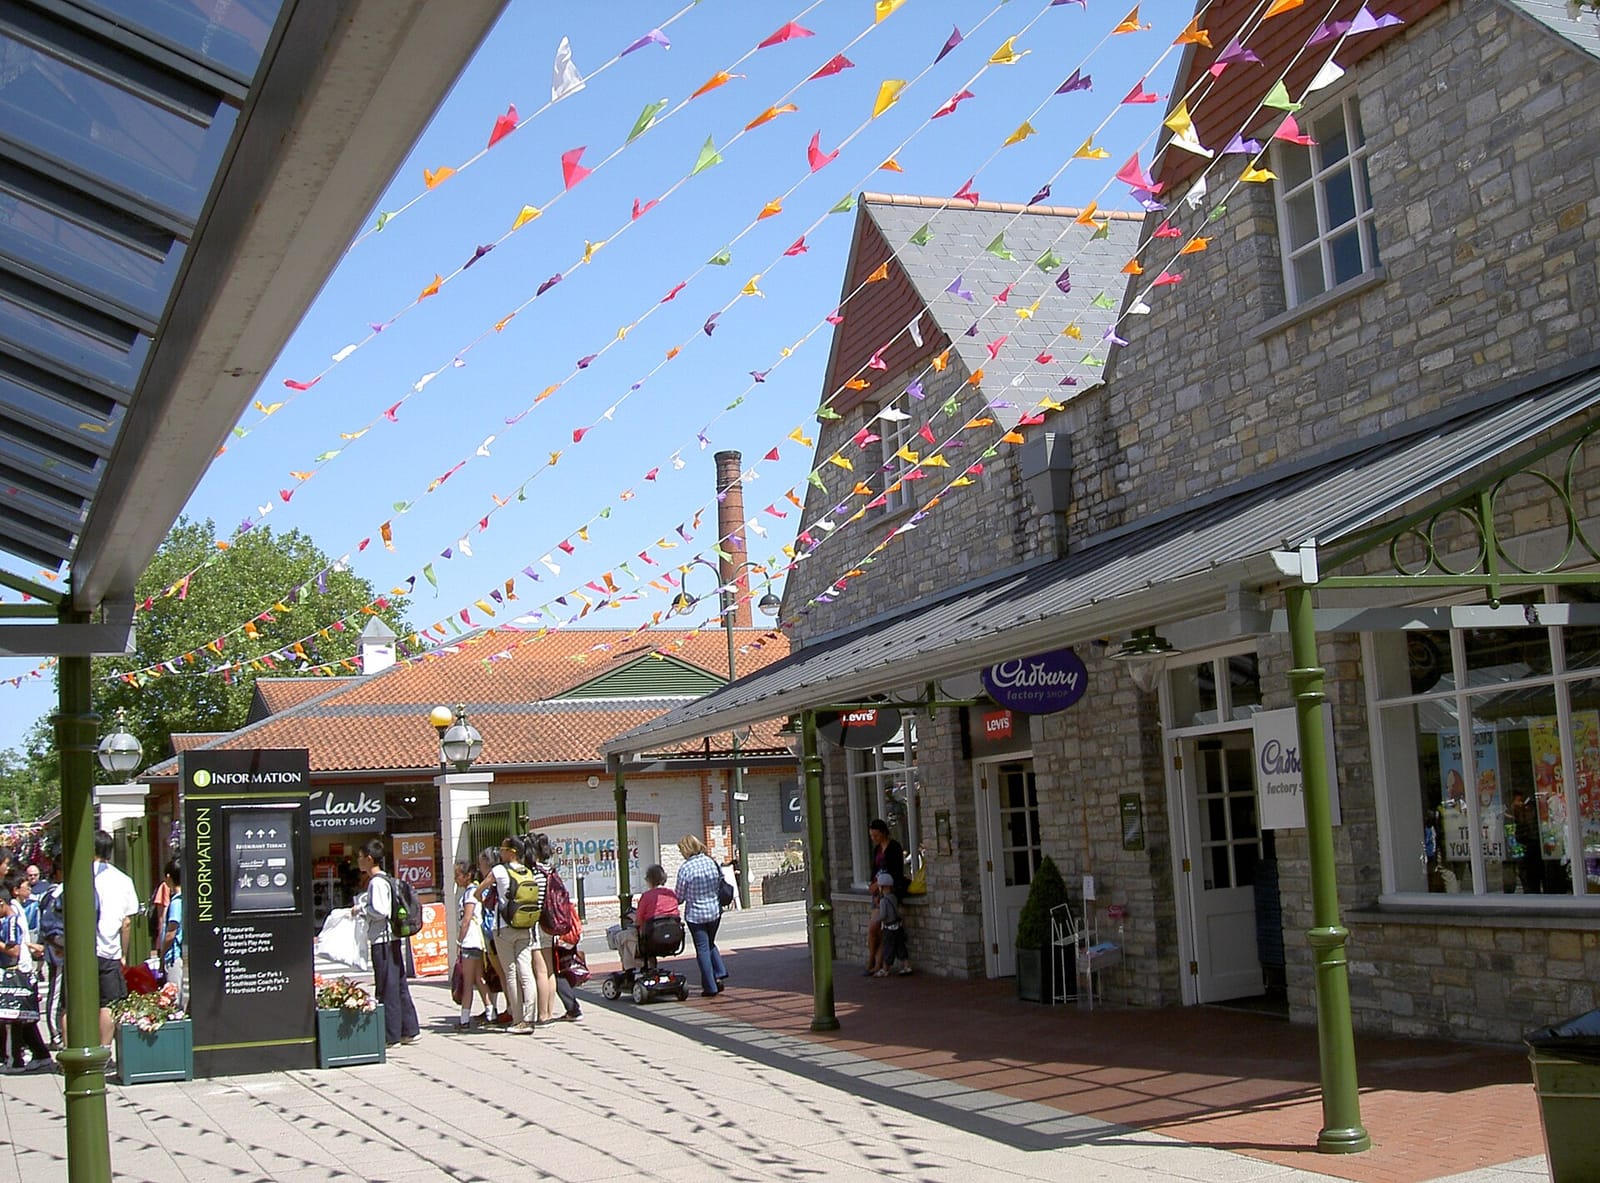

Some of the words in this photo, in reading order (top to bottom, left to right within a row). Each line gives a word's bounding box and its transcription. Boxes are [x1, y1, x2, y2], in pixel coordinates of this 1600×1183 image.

[991, 658, 1079, 691] Cadbury
[1007, 689, 1044, 701] factory
[1047, 690, 1069, 698] SHOP
[1261, 739, 1302, 776] Cadb
[212, 772, 302, 785] INFORMATION
[1266, 782, 1298, 796] factory
[349, 817, 376, 826] SHOP
[565, 838, 615, 855] more
[600, 847, 639, 861] mre
[196, 808, 213, 922] INFORMATION
[399, 866, 432, 882] 70%
